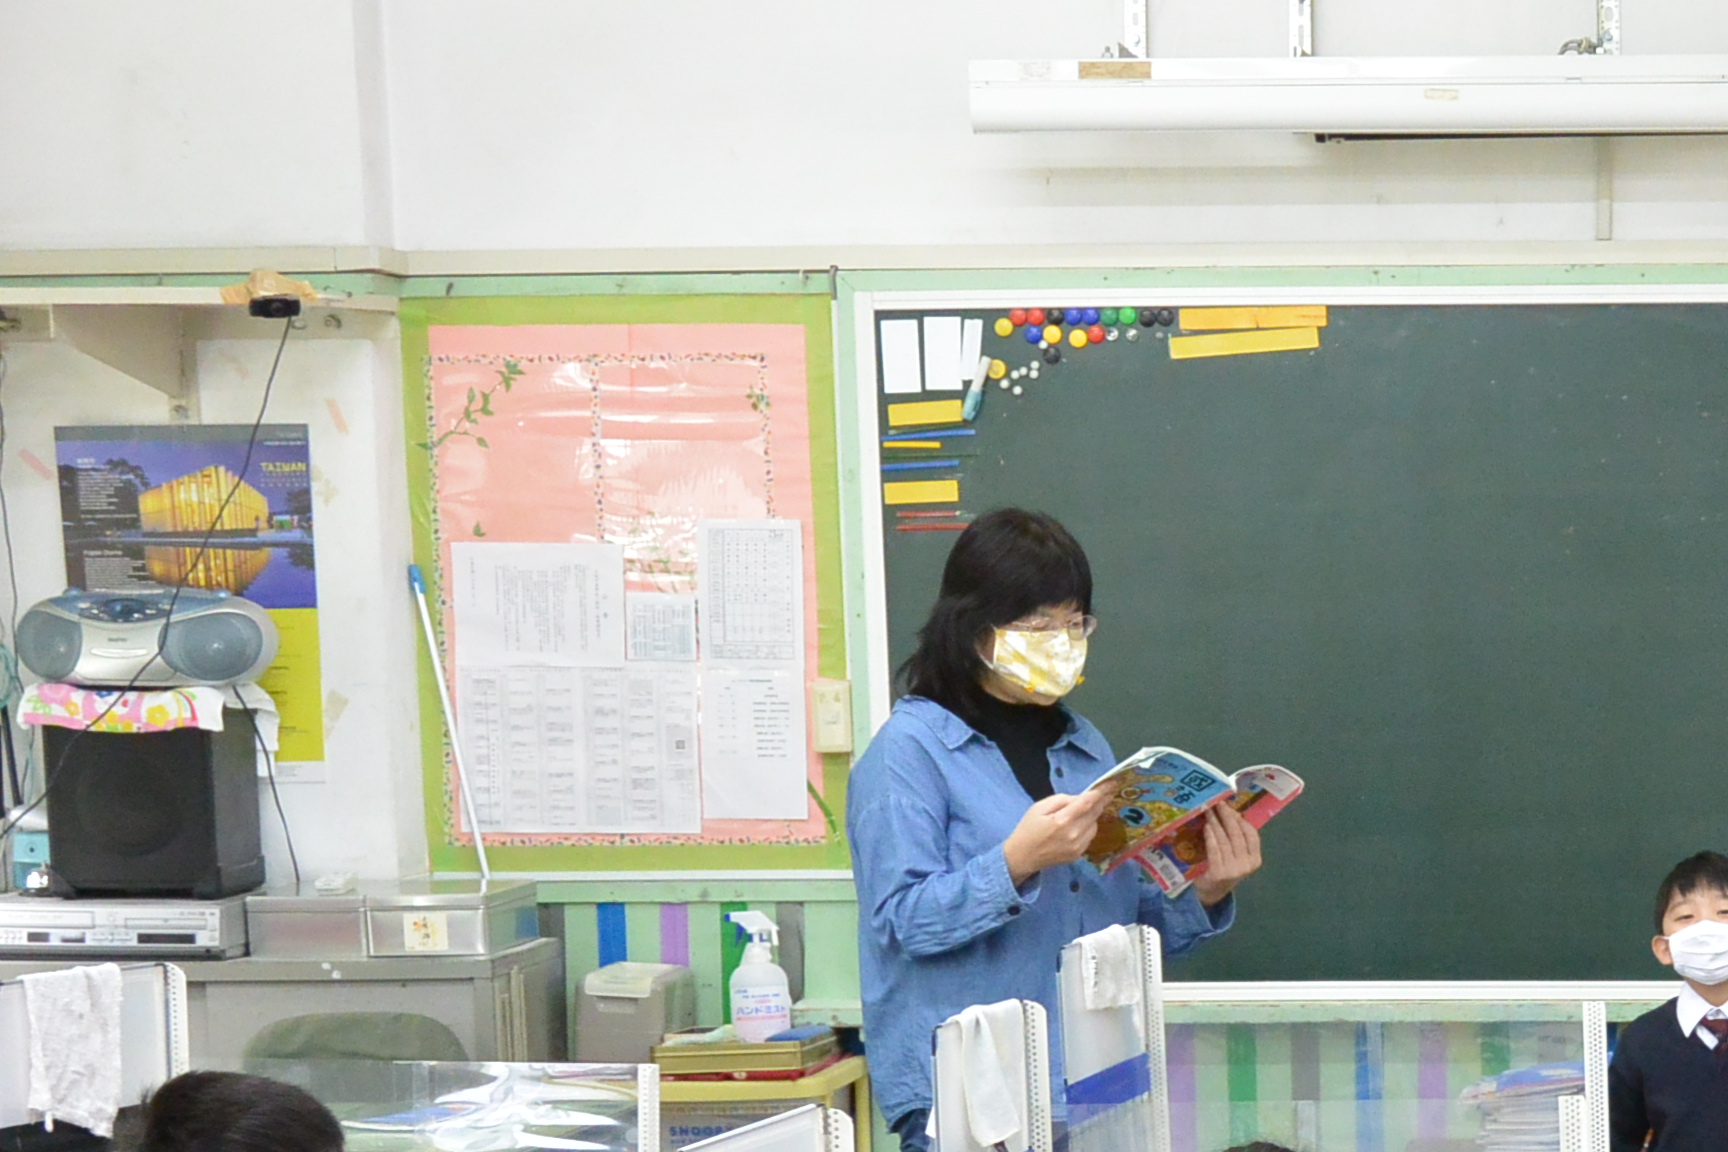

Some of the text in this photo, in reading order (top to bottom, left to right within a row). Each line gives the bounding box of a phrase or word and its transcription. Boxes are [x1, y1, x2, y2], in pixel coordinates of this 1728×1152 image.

[260, 461, 307, 472] TAIWAN
[1124, 808, 1144, 825] 2
[736, 1005, 787, 1015] ハンドミスト
